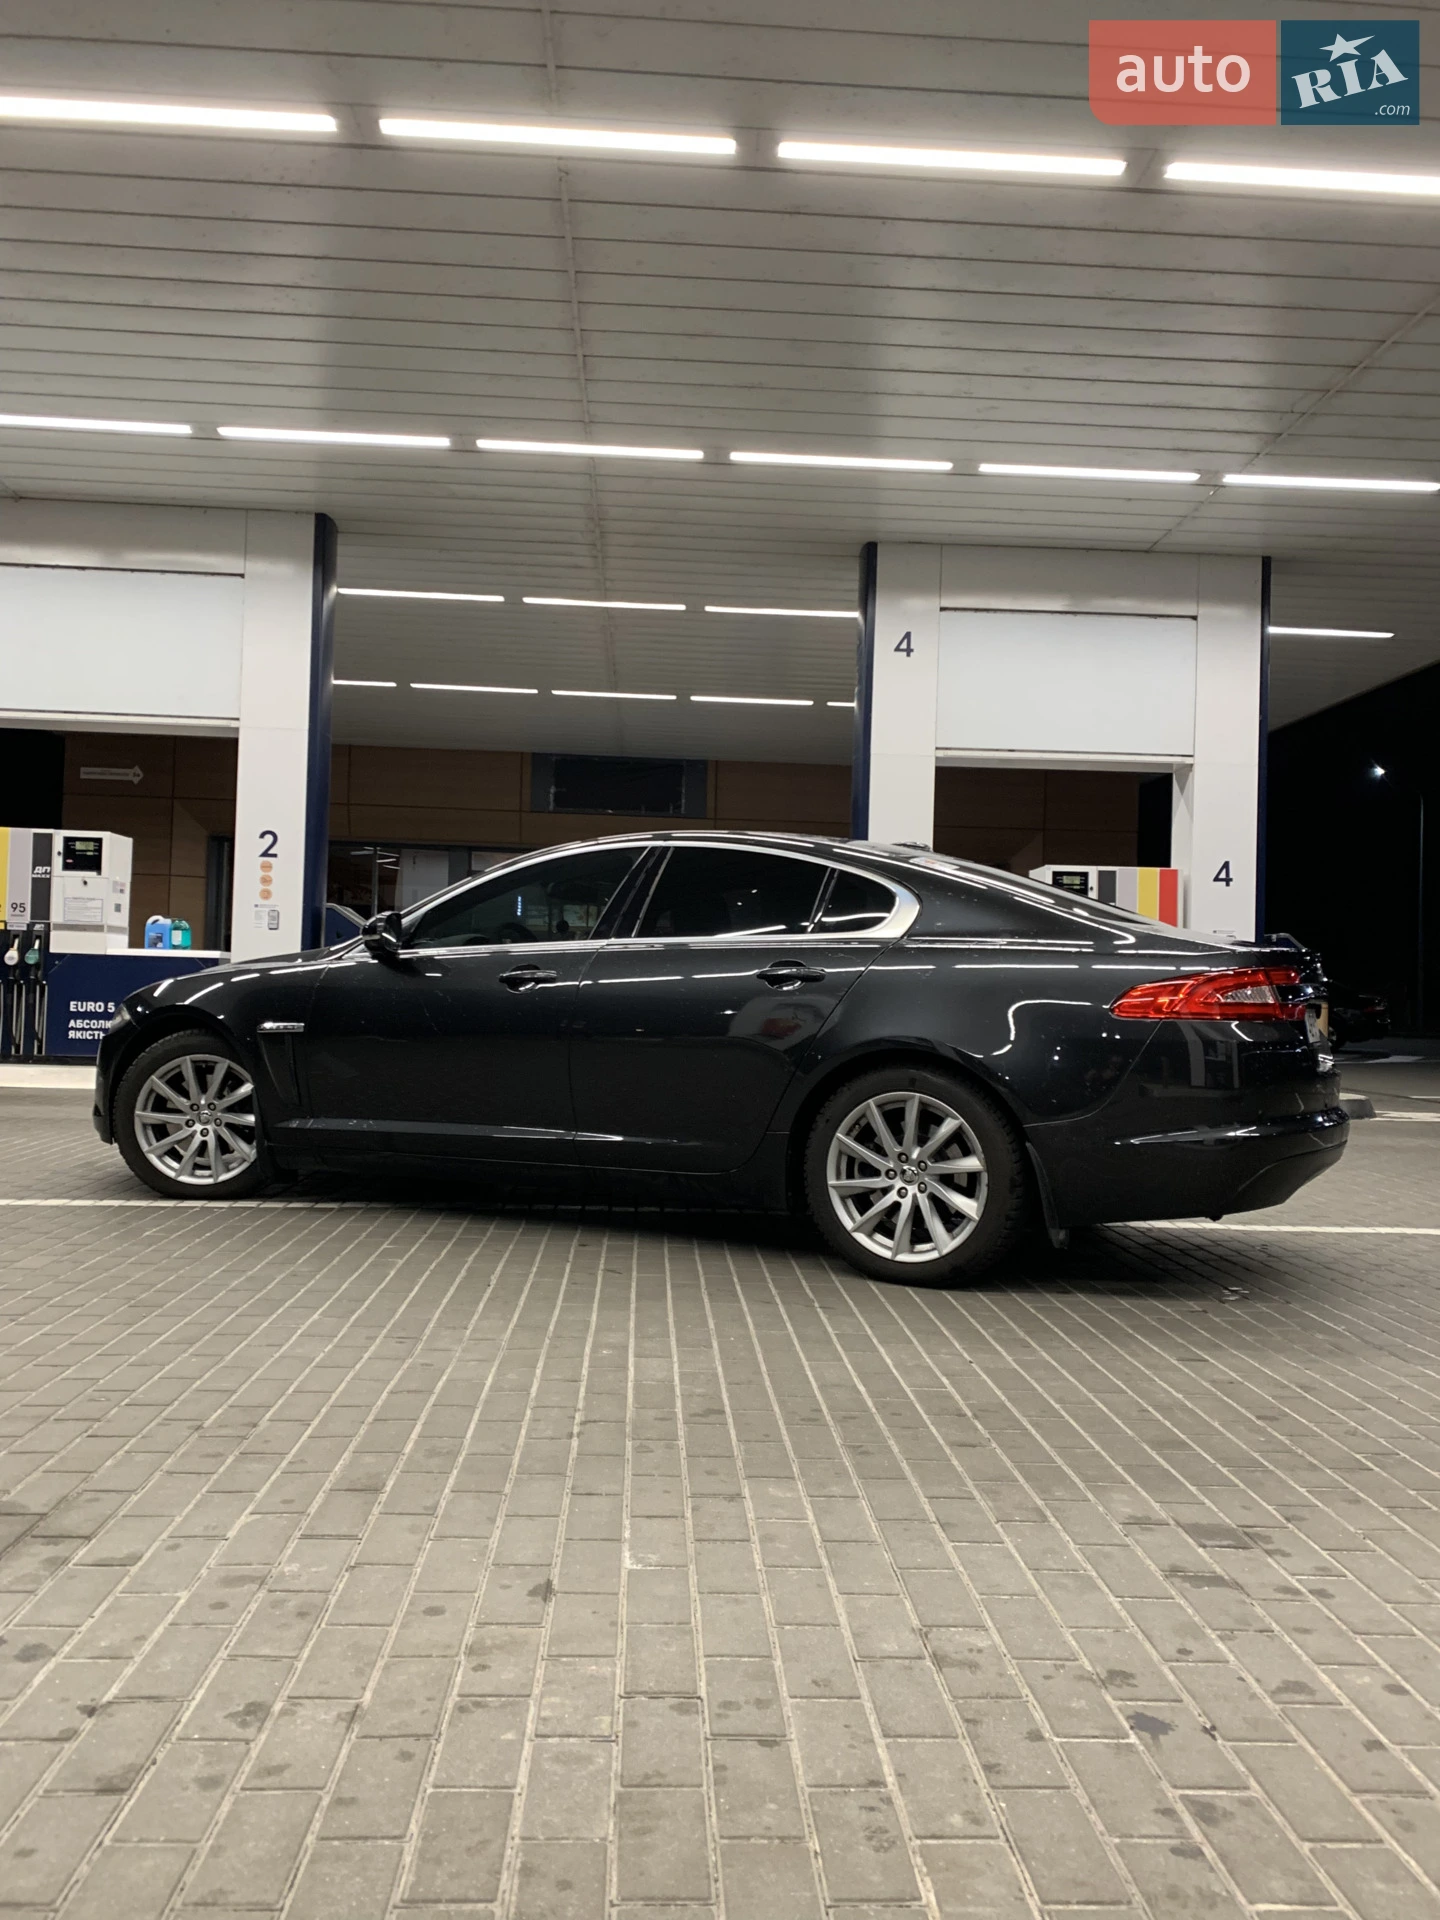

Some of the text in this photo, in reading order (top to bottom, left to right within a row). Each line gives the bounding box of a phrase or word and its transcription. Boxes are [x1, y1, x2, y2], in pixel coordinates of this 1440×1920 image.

[893, 631, 914, 658] 4
[258, 829, 279, 859] 2
[1212, 860, 1234, 888] 4
[10, 902, 26, 914] 95
[69, 1001, 116, 1013] EURO 5
